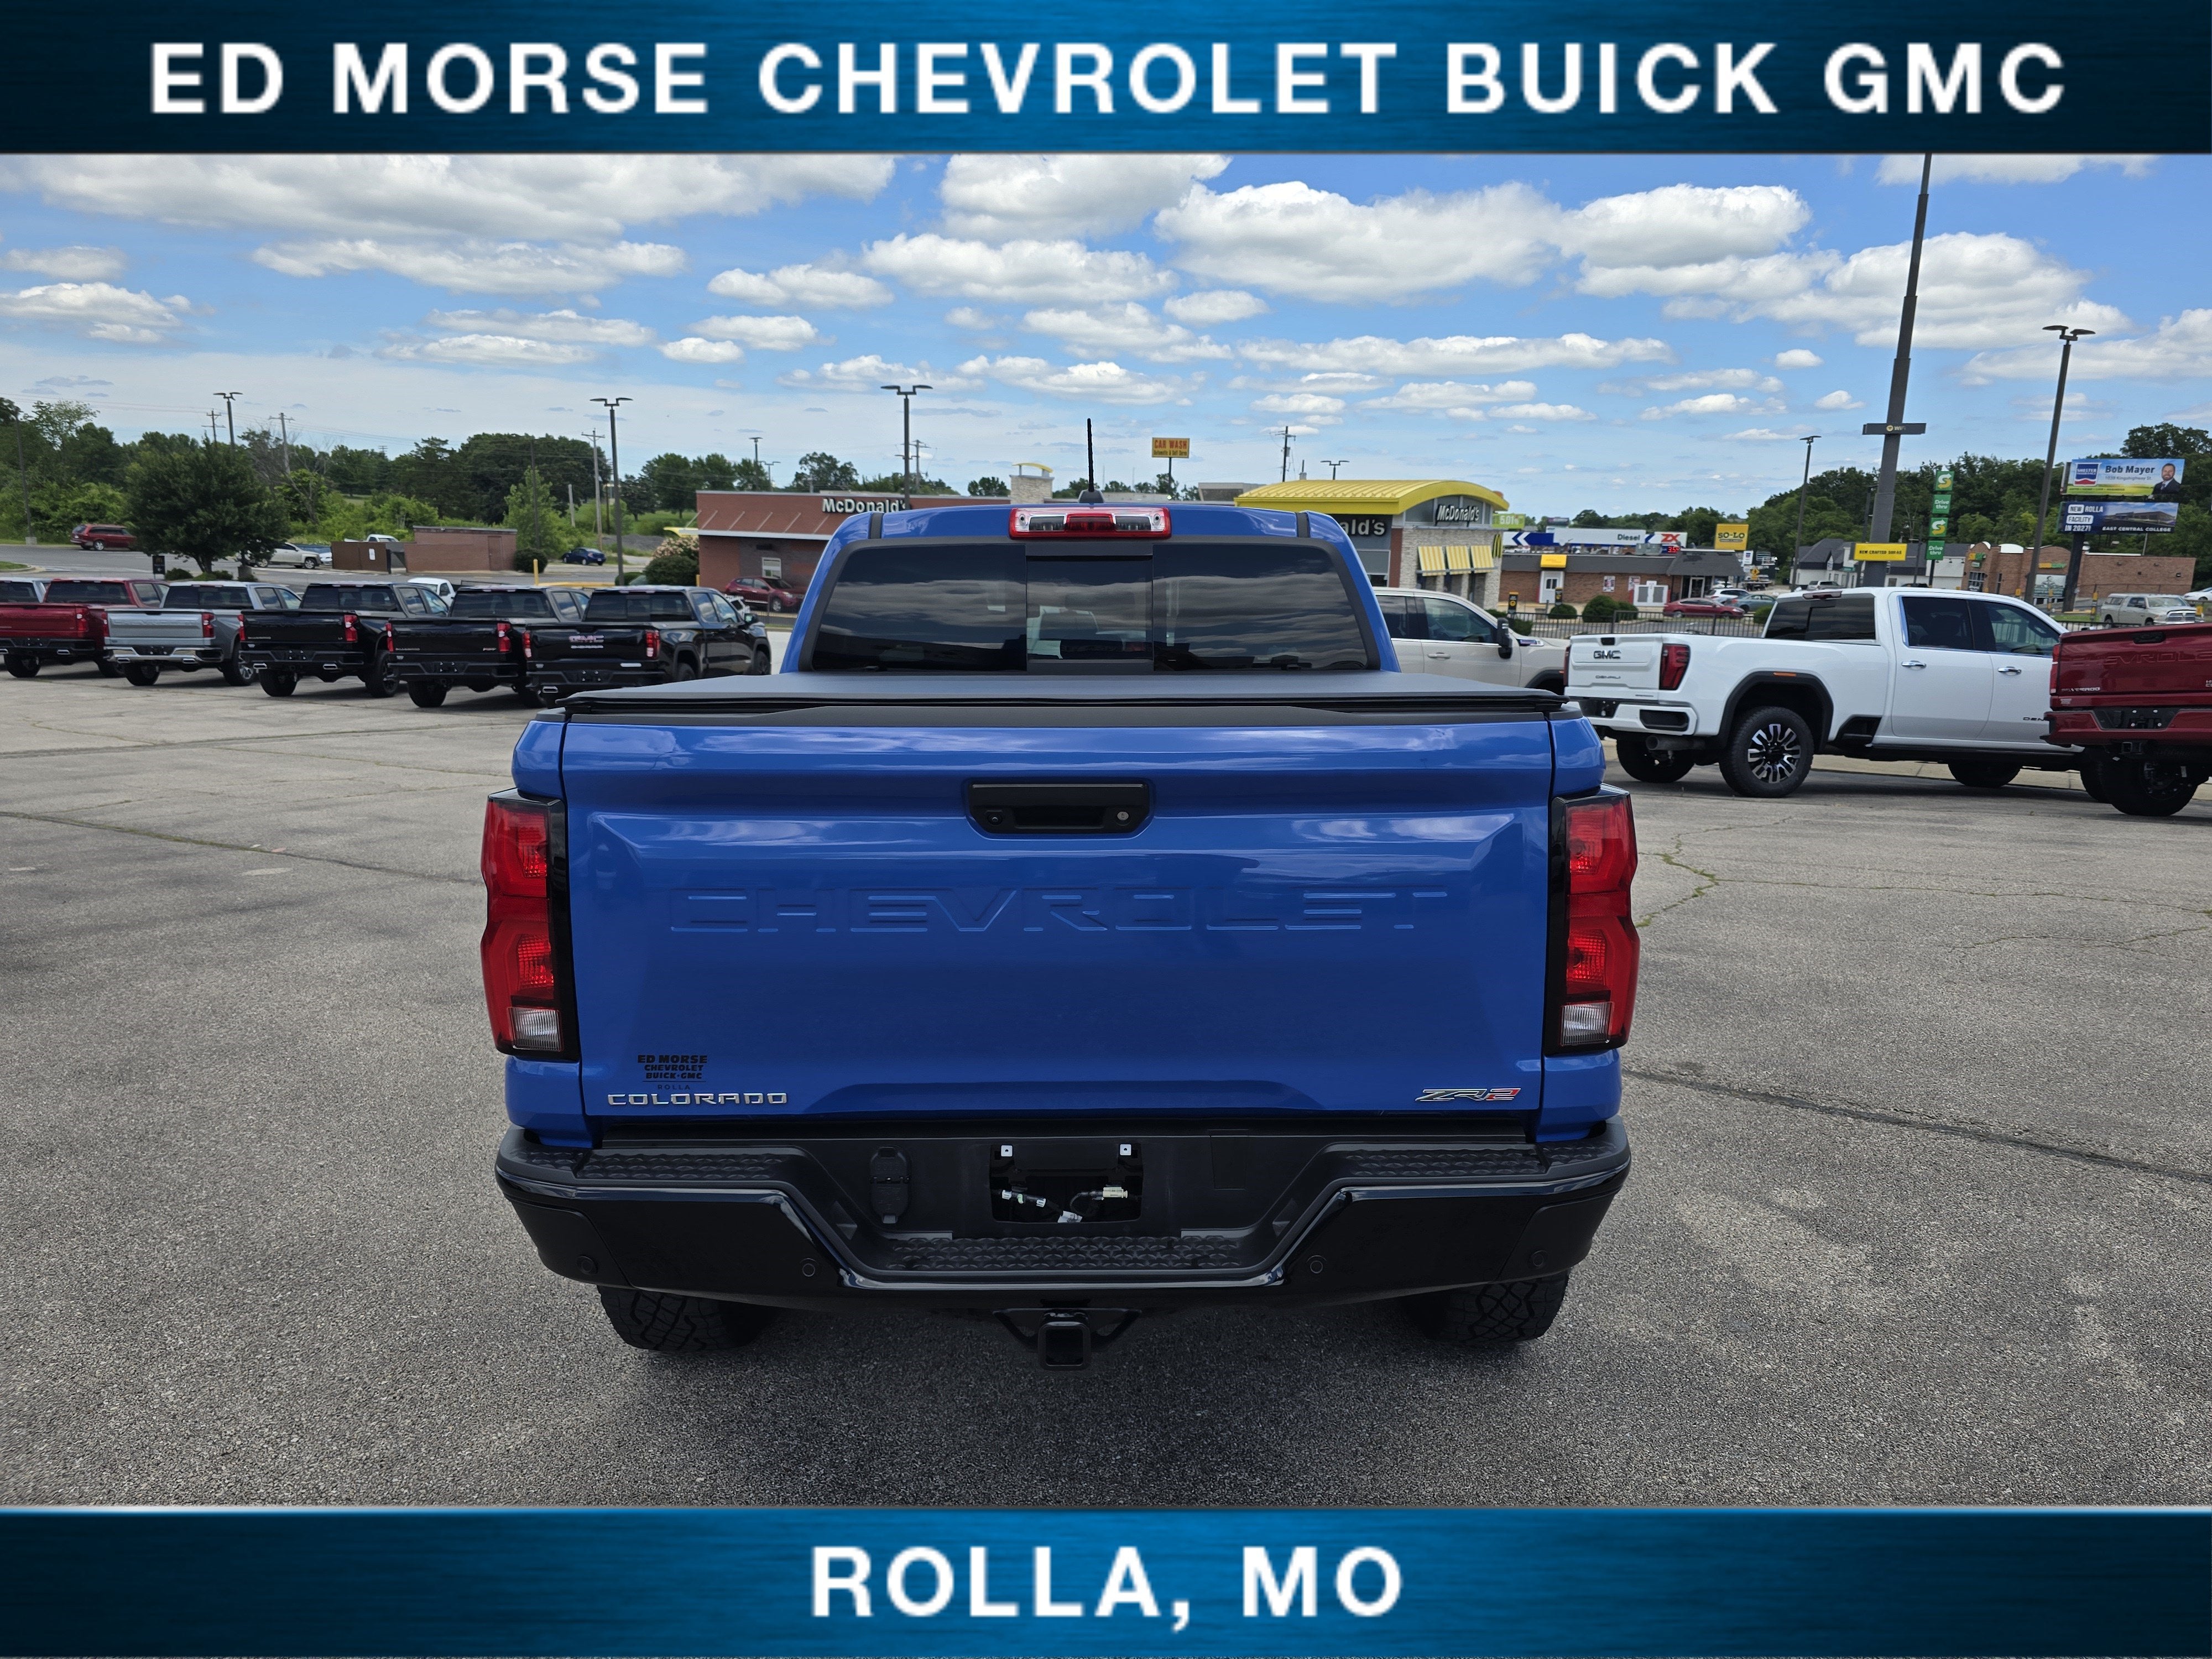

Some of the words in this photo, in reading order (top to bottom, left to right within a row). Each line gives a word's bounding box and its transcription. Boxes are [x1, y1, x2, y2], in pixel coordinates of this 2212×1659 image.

[1154, 440, 1167, 448] CAR
[1169, 440, 1187, 449] WASH
[2125, 466, 2156, 476] Mayer
[1437, 505, 1479, 521] McDonald's
[1718, 531, 1745, 539] SO-LO
[1593, 650, 1621, 659] GMC
[669, 886, 1447, 933] CHEVROLET
[638, 1055, 656, 1063] ED
[658, 1055, 708, 1063] MORSE
[607, 1093, 787, 1105] COLORADO
[1415, 1088, 1521, 1102] ZR2
